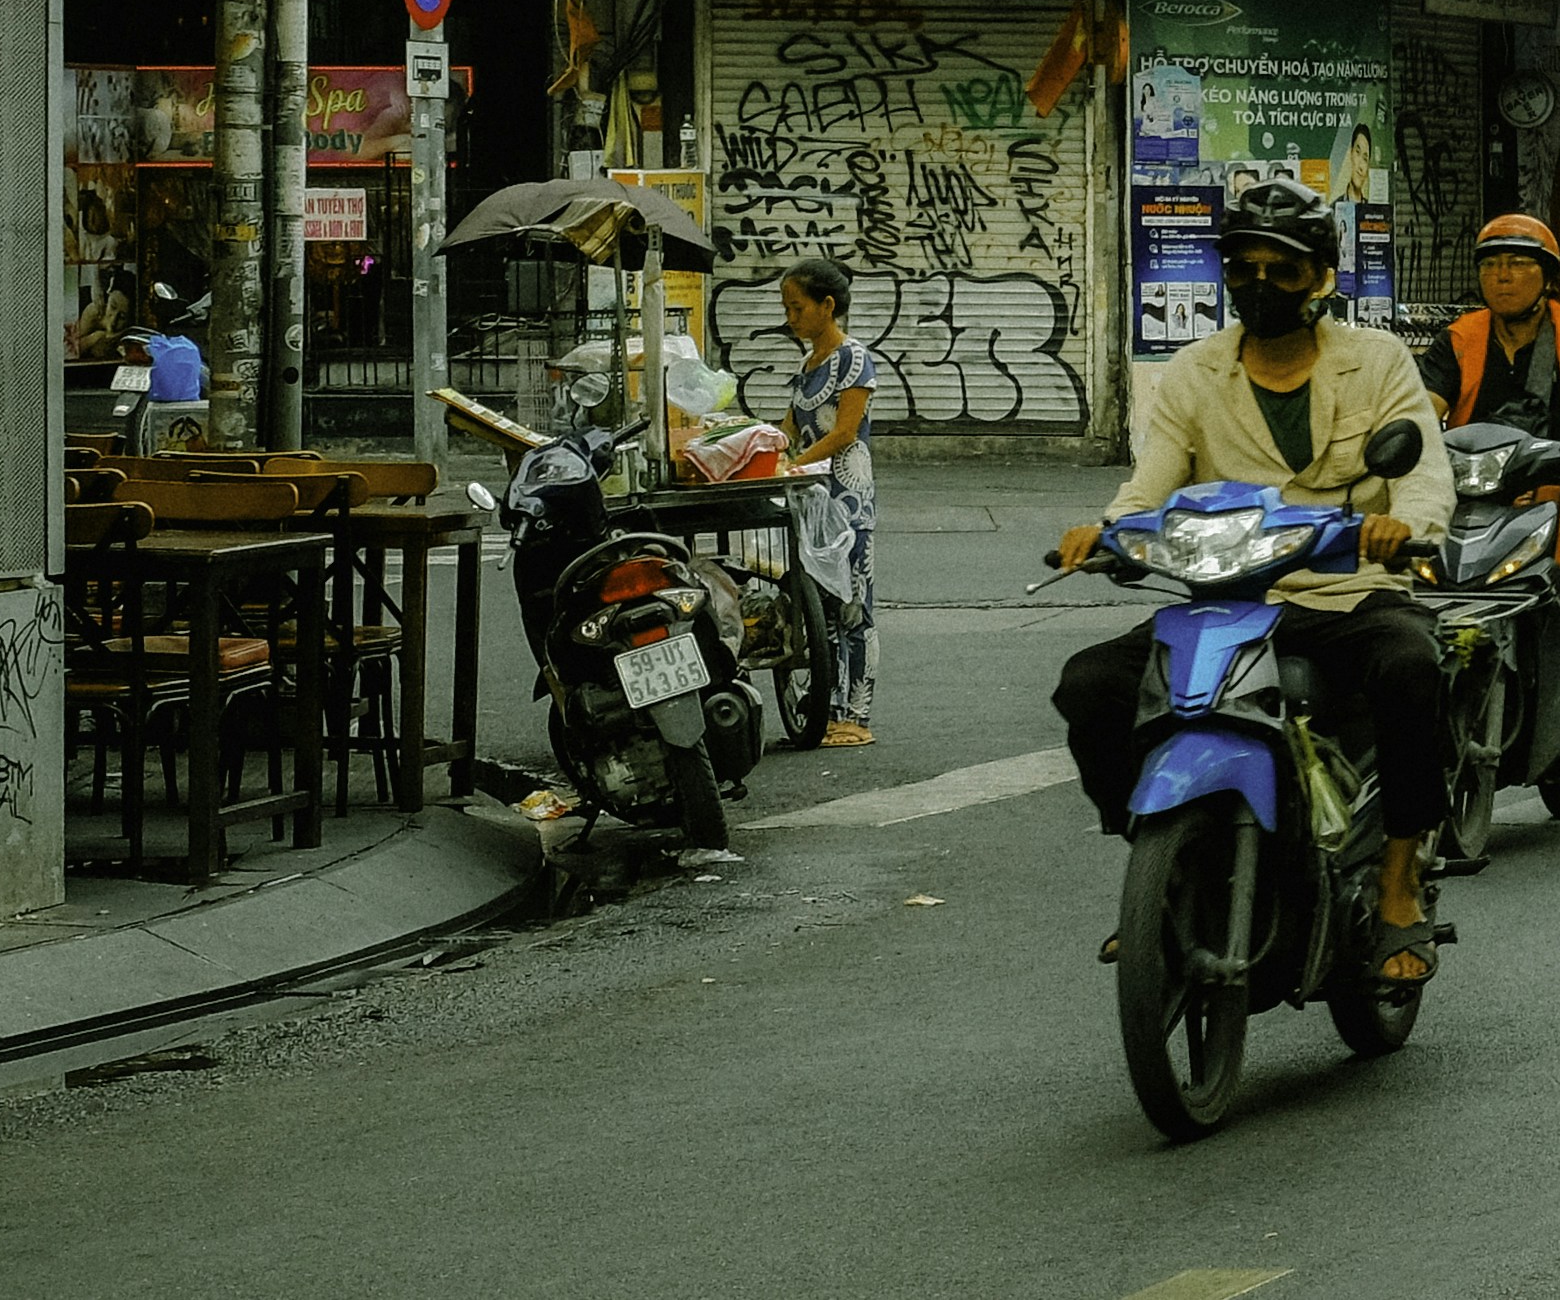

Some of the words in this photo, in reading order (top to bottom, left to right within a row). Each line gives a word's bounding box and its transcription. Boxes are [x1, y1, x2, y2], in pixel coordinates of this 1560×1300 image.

[1154, 1, 1221, 16] Berocca
[1213, 52, 1279, 76] CHUYỂN
[1281, 55, 1311, 77] HOÁ
[1312, 61, 1335, 81] TẠO
[1236, 86, 1279, 105] NĂNG
[1281, 88, 1323, 108] LƯỢNG
[1324, 91, 1356, 107] TRONG
[1269, 108, 1298, 127] TÍCH
[1300, 112, 1324, 130] CỰC
[1325, 115, 1337, 127] ĐI
[1339, 114, 1352, 128] XA
[629, 661, 703, 702] 543.65
